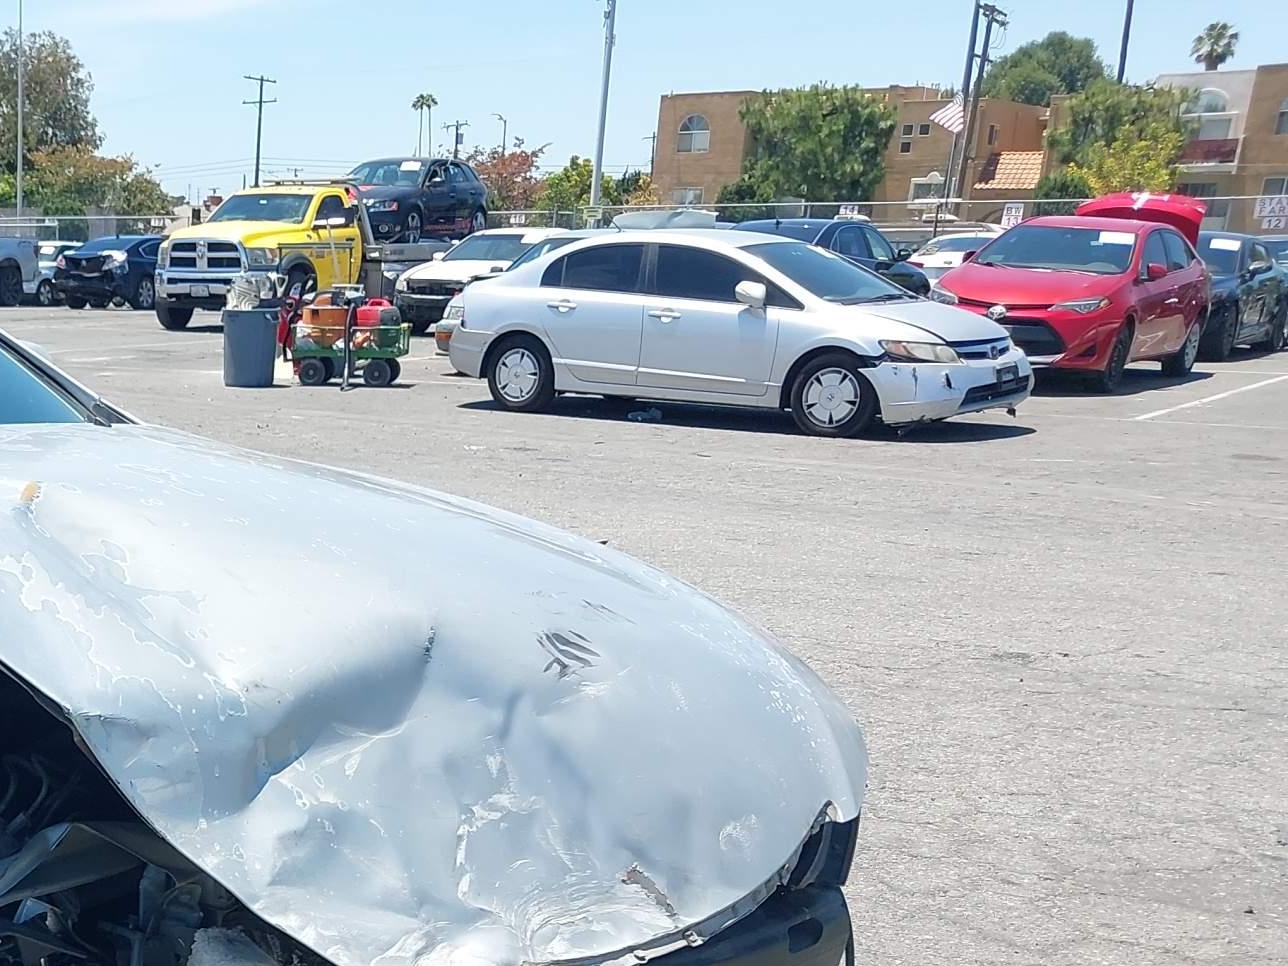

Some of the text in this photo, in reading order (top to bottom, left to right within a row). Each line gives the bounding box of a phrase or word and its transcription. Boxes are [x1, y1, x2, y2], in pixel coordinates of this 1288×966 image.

[1258, 198, 1288, 207] STA
[1006, 207, 1022, 215] BW
[1005, 216, 1019, 226] 13
[1266, 218, 1282, 228] 12
